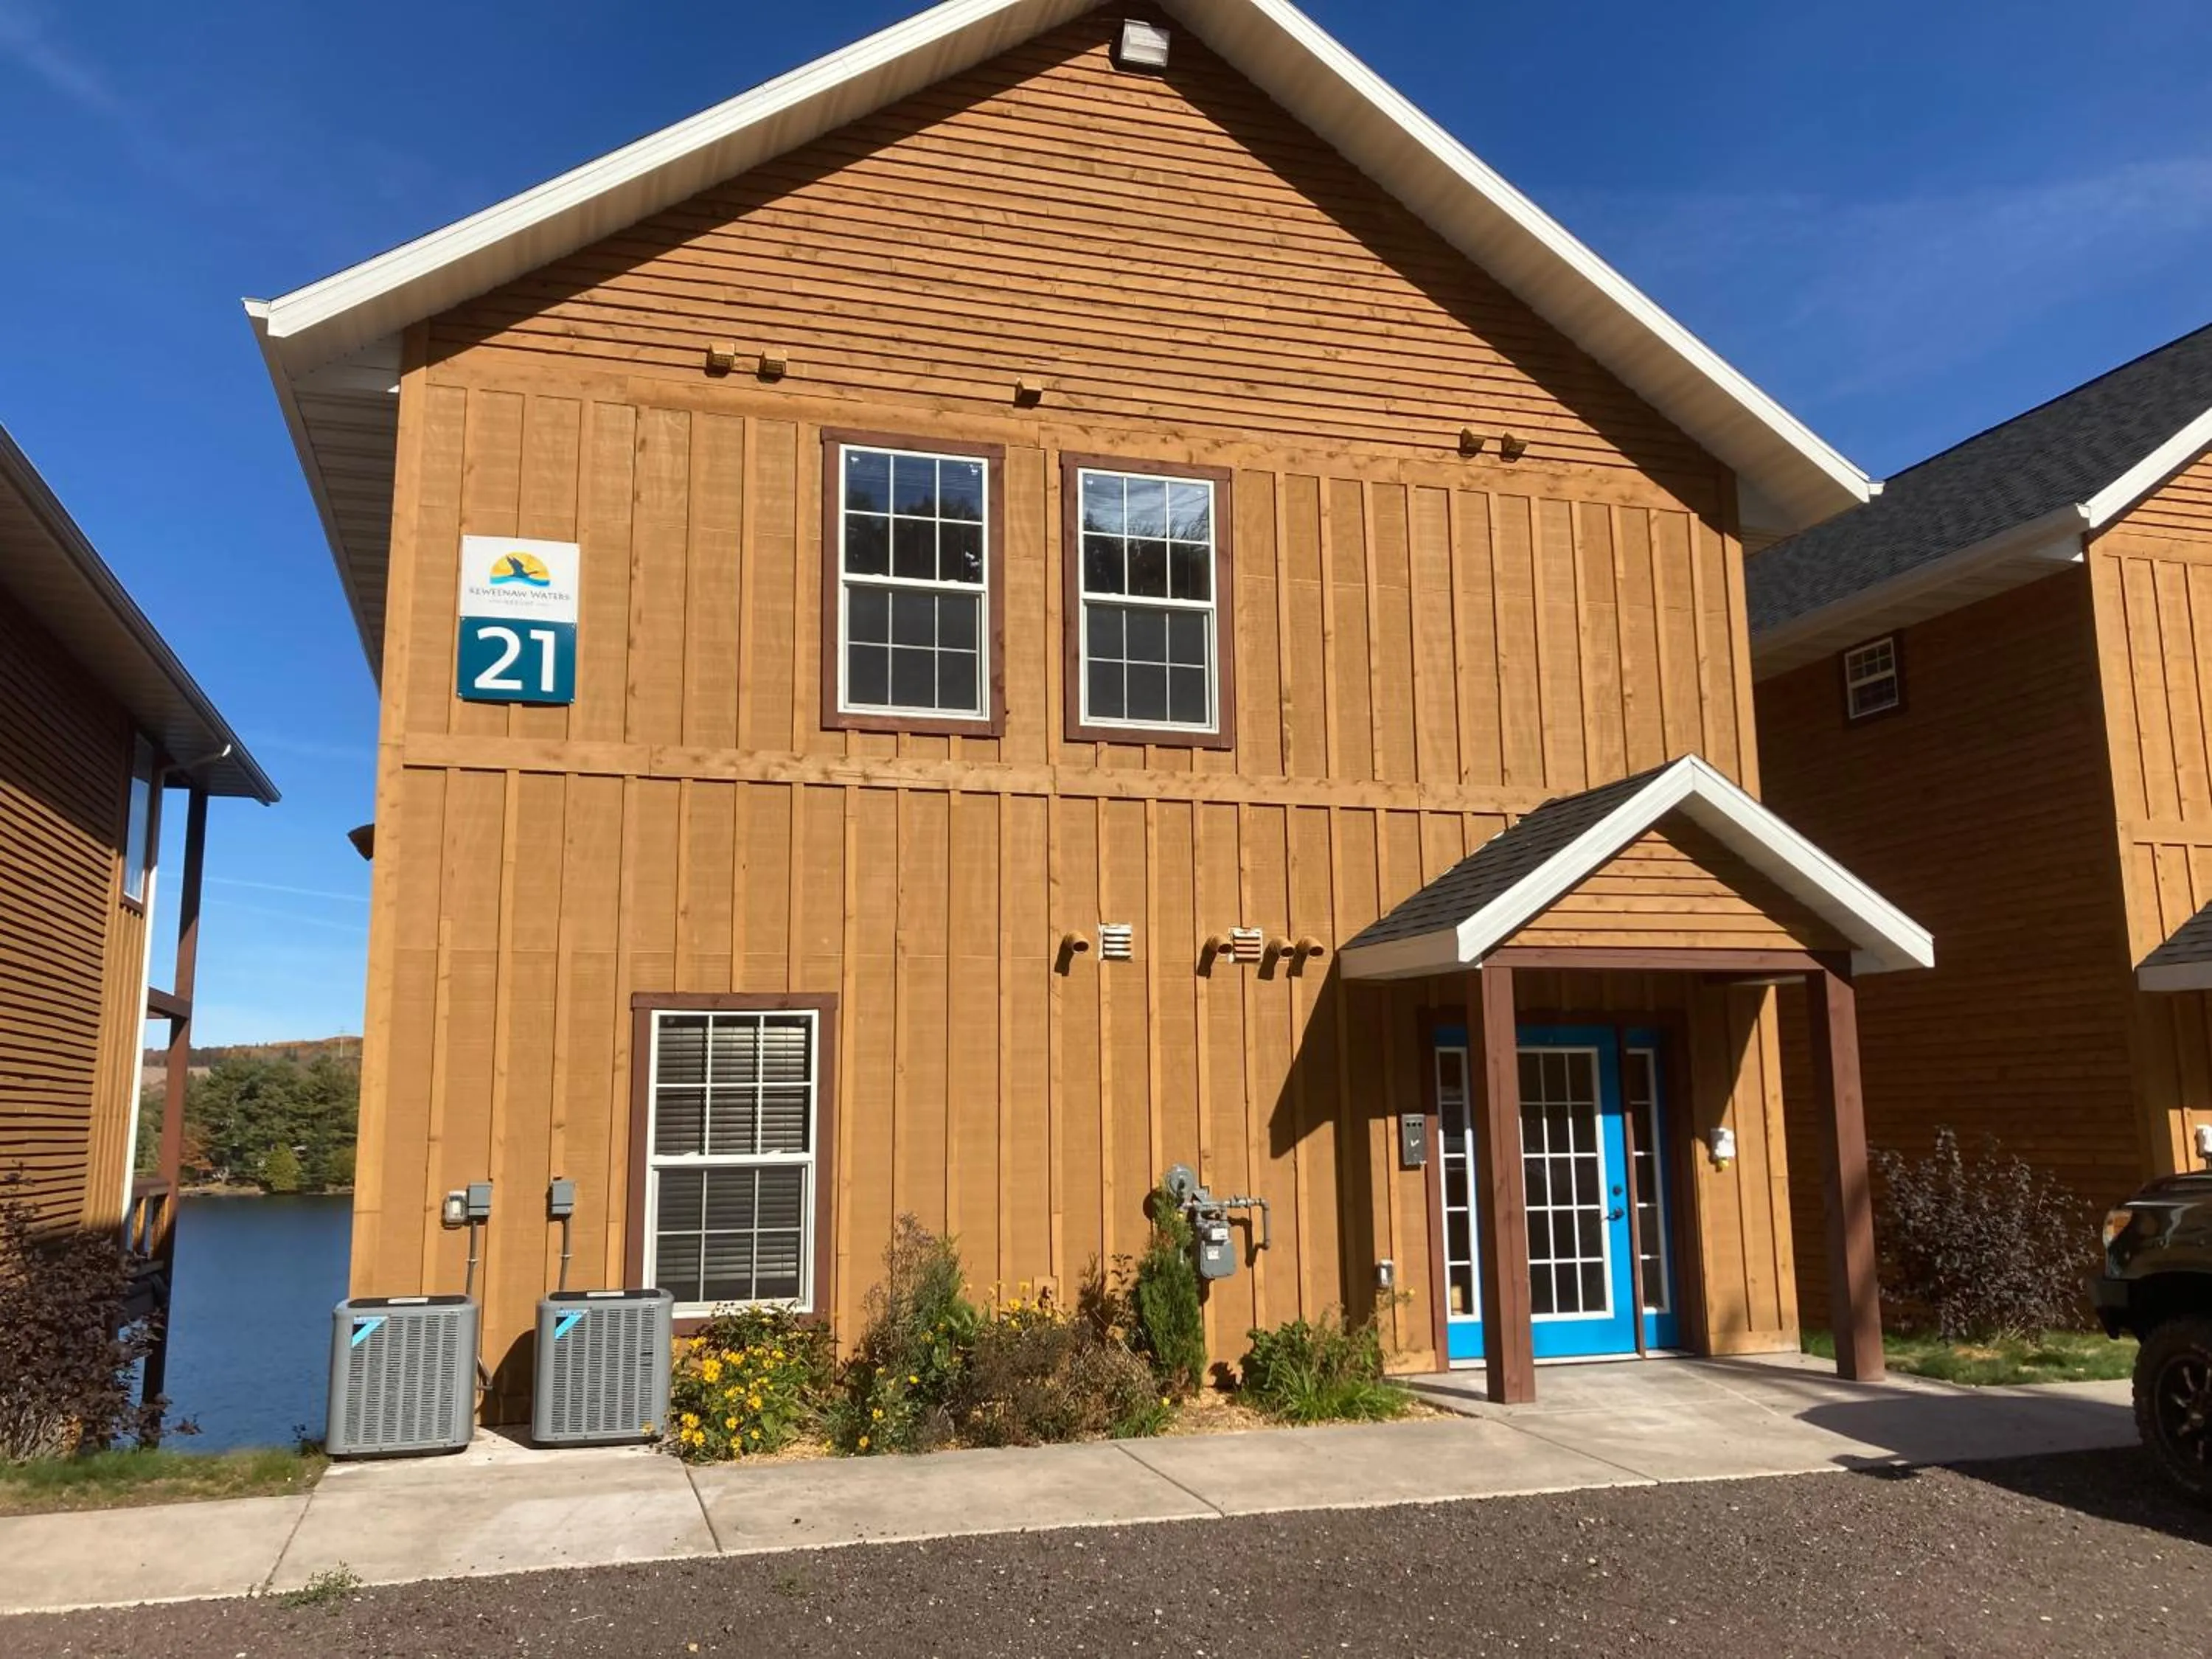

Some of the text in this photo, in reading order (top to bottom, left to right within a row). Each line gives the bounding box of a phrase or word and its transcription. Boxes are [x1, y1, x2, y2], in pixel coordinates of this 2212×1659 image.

[469, 587, 571, 601] KEWEENAW WATERS
[474, 626, 555, 692] 21
